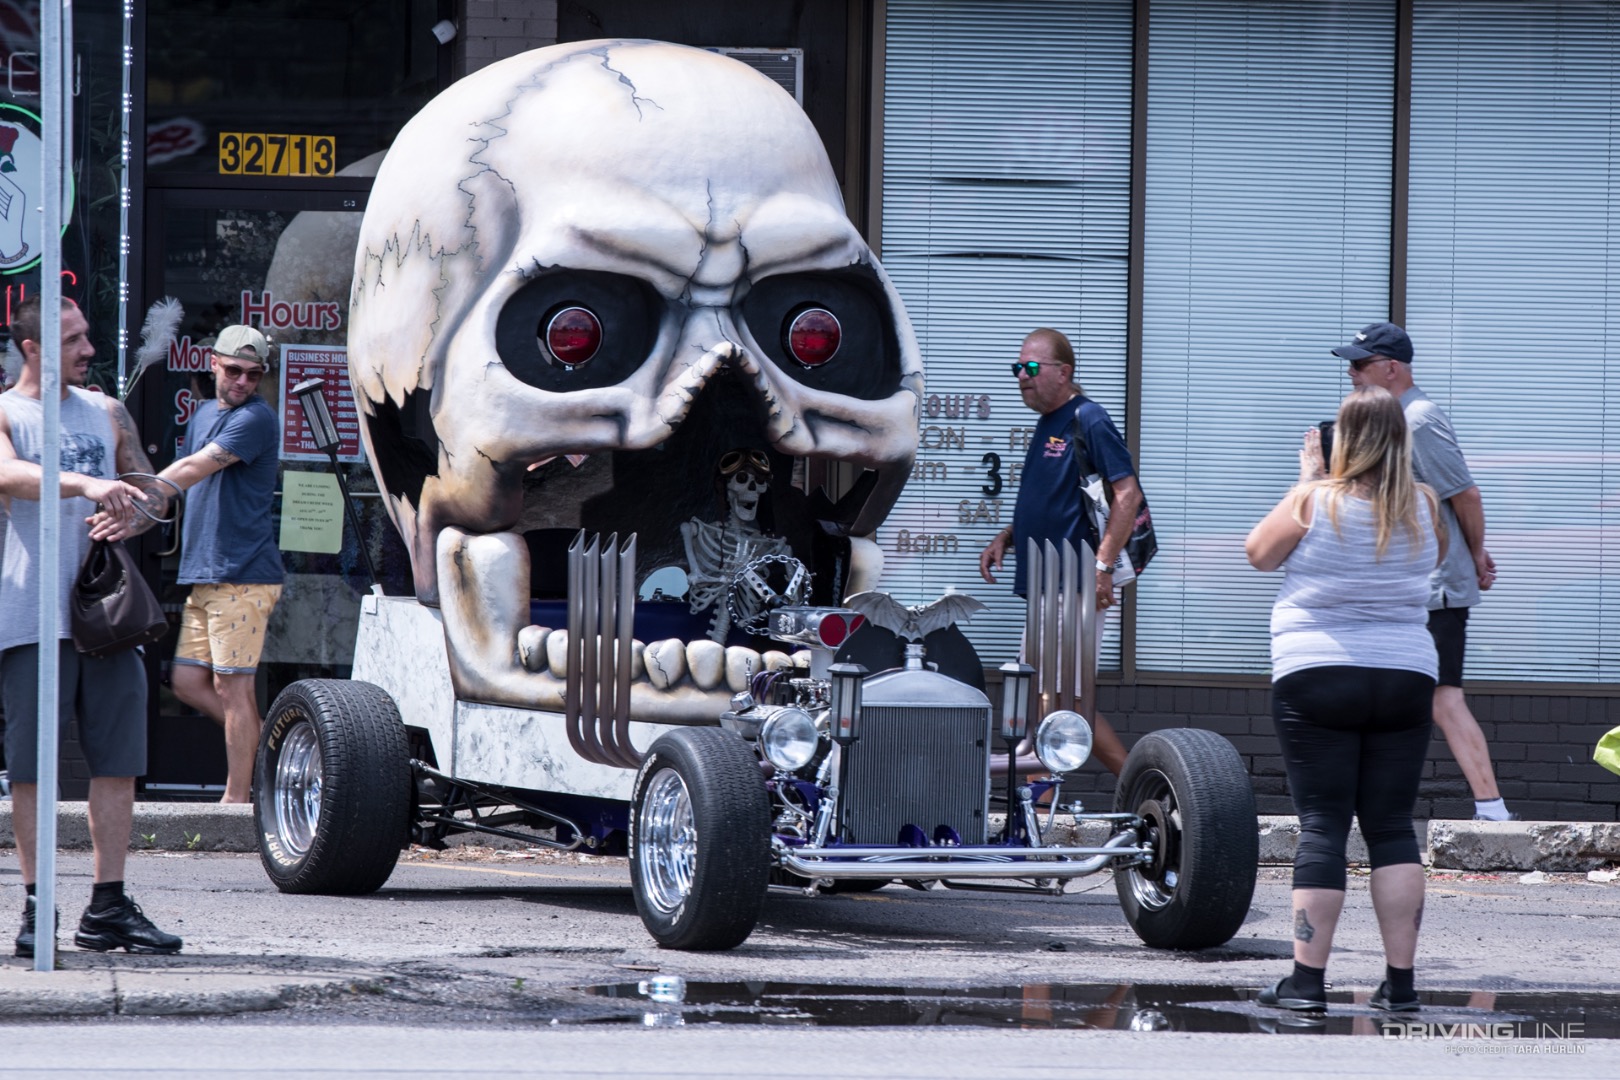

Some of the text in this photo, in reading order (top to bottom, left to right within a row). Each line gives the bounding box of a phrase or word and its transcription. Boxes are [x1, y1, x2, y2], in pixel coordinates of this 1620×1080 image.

[220, 136, 334, 176] 32713
[241, 290, 341, 330] Hours
[288, 352, 348, 363] BUSINESS HOU
[926, 393, 991, 419] ours
[922, 426, 965, 449] ON
[981, 452, 1003, 496] 3
[958, 500, 1003, 523] SAT
[896, 529, 959, 552] 8am
